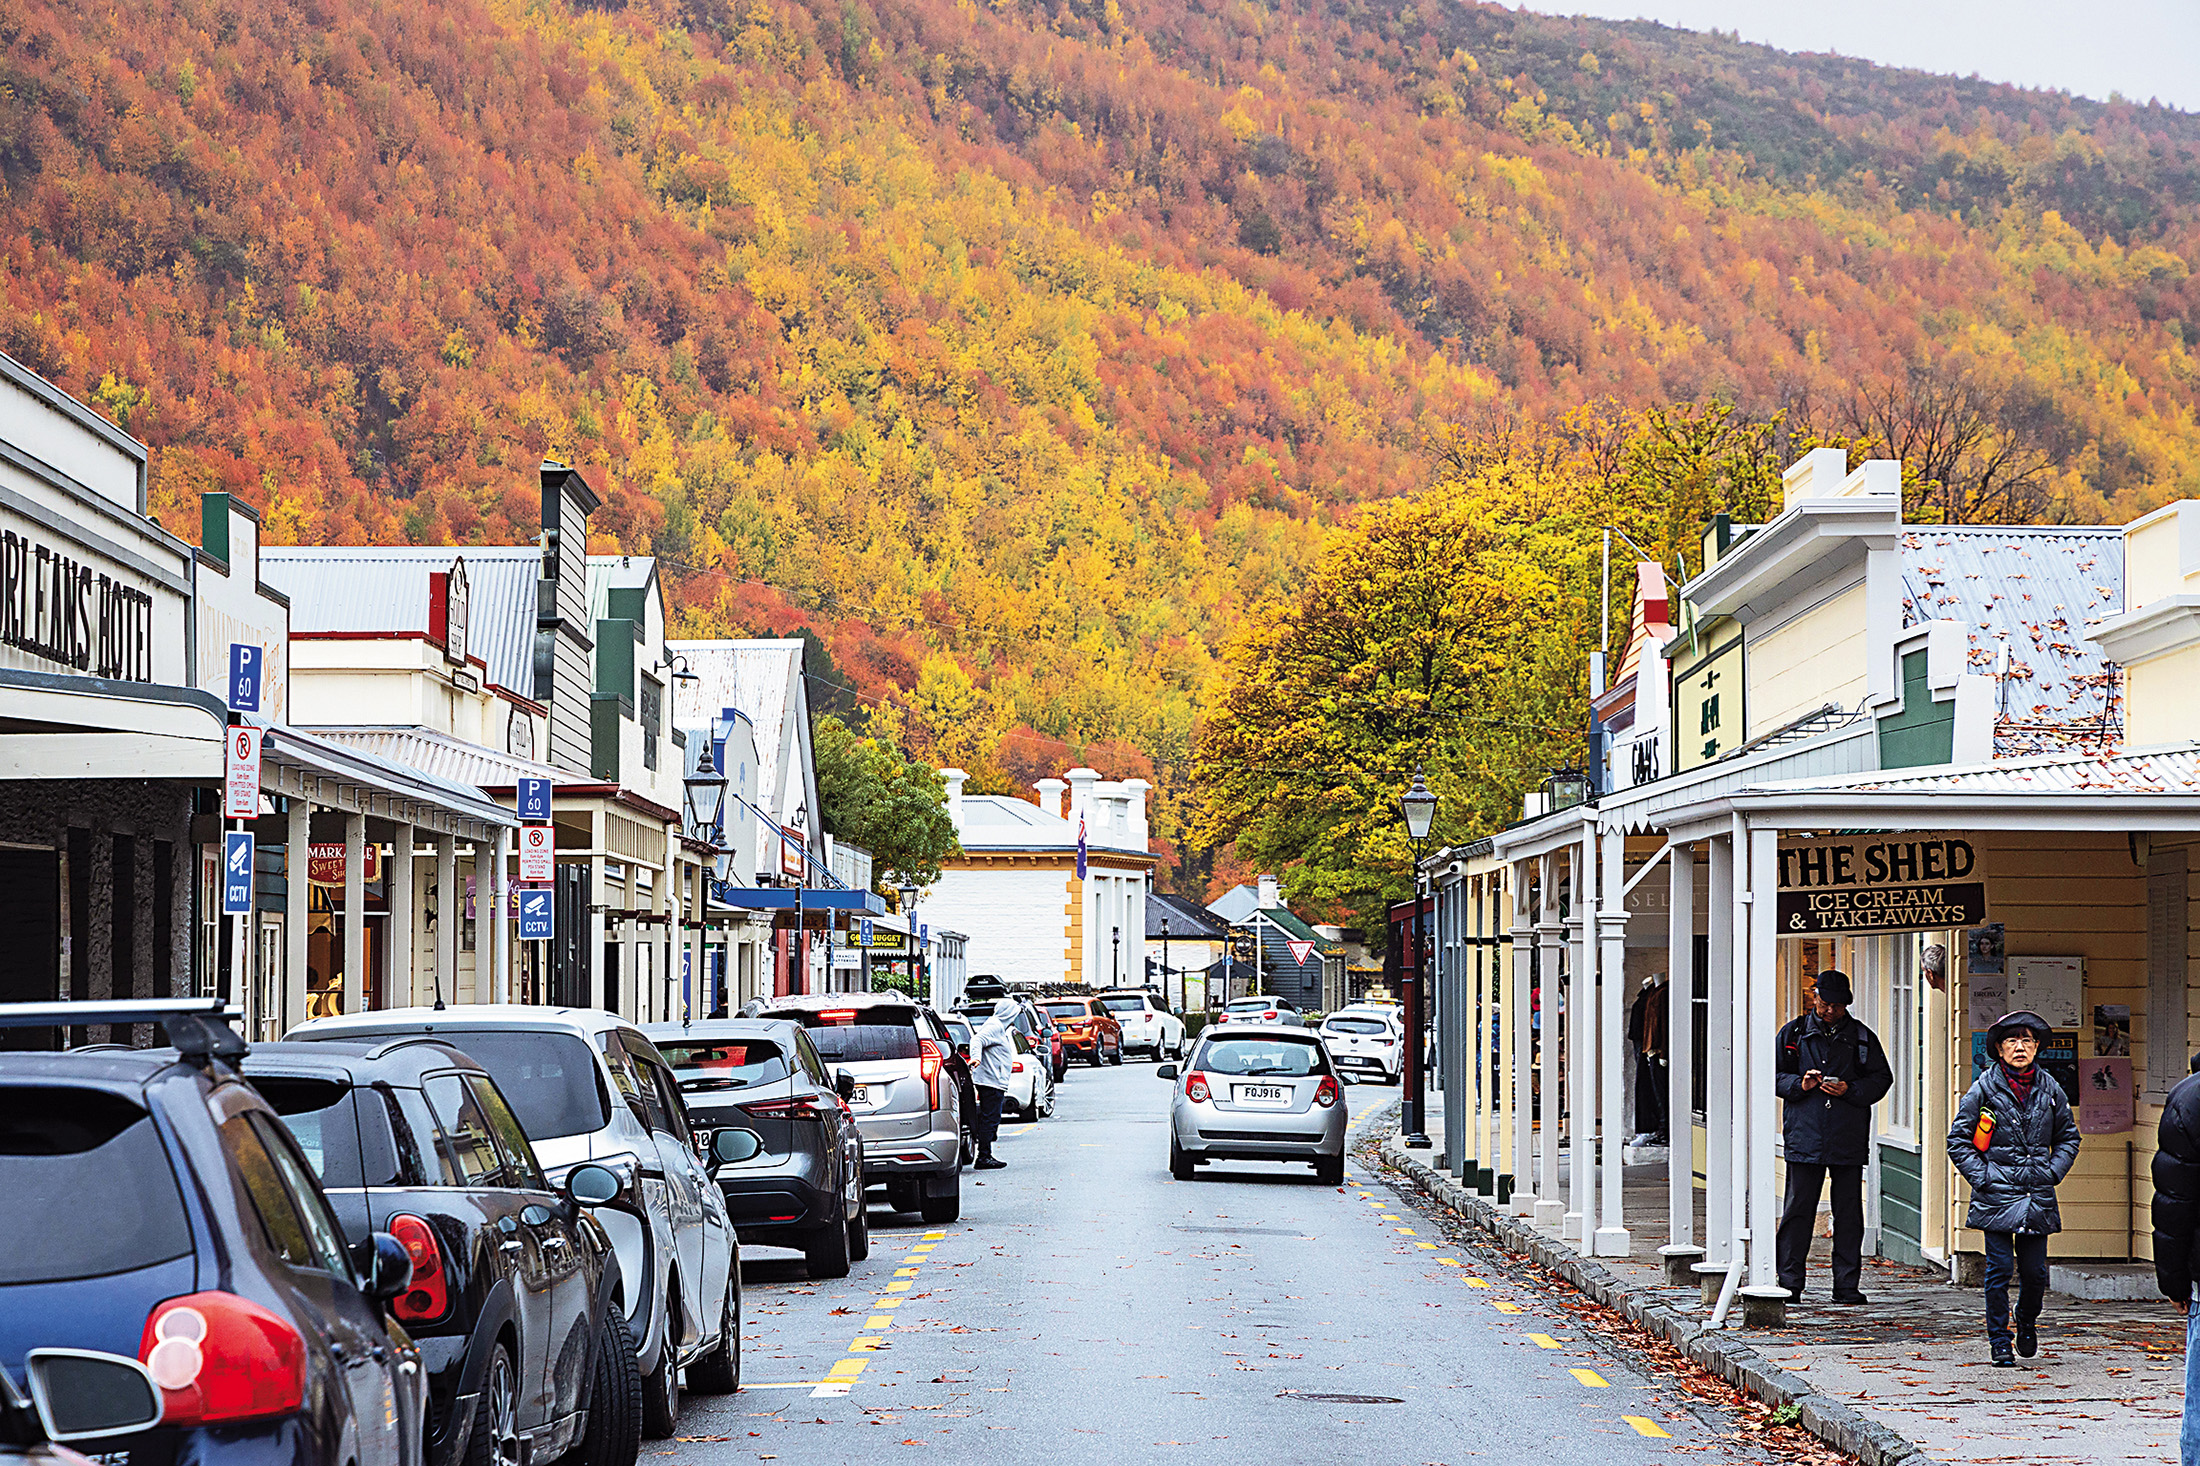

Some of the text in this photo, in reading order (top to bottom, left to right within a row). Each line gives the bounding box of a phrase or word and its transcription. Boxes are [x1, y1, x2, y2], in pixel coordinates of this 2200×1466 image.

[0, 529, 152, 684] RLEANS HOTEL
[240, 648, 252, 673] P
[238, 677, 251, 697] 60
[529, 780, 540, 796] P
[528, 798, 541, 810] 60
[311, 859, 344, 875] SWEET
[1777, 838, 1976, 888] THE SHED
[332, 868, 346, 881] SHO
[229, 885, 248, 902] CCTV
[1807, 888, 1945, 911] ICE CREAM
[1789, 905, 1966, 930] & TAKEAWAYS
[525, 921, 548, 932] CCTV
[873, 934, 902, 942] NUGGET
[1245, 1087, 1281, 1099] FQJ916
